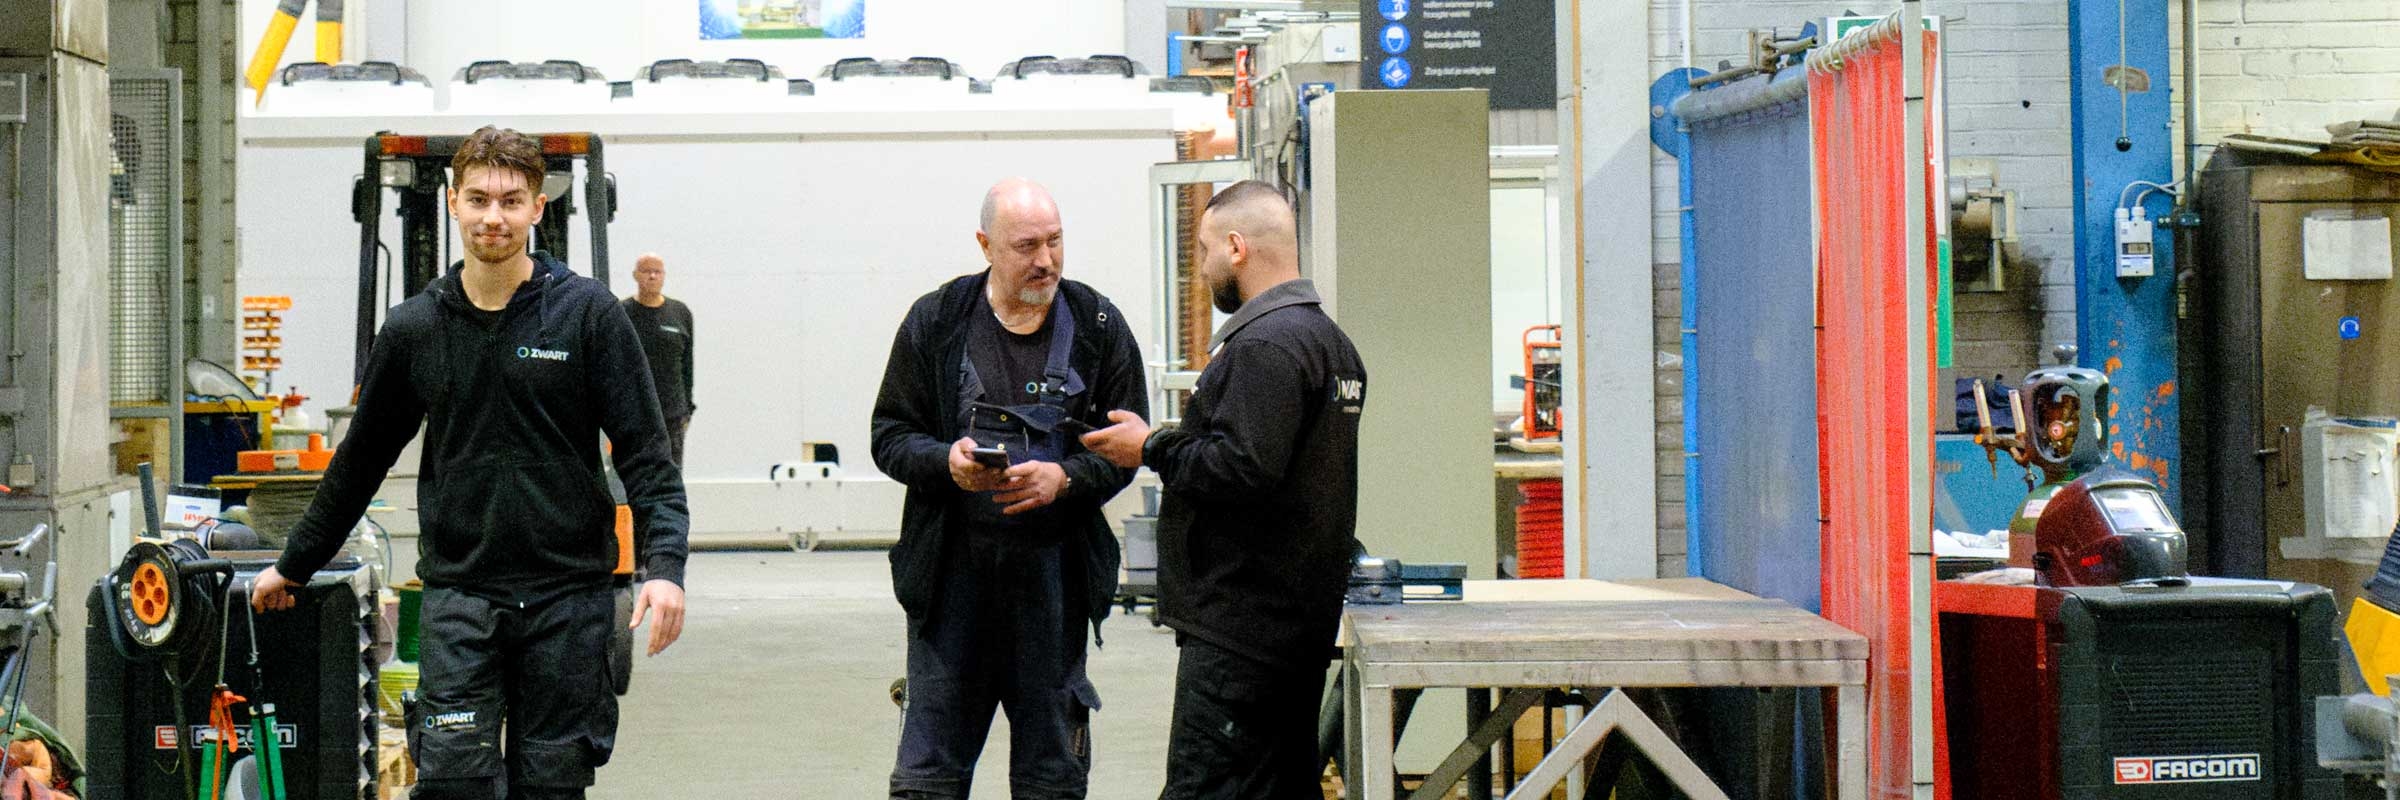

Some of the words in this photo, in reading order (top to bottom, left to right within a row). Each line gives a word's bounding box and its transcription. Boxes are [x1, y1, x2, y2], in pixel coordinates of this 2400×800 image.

[530, 348, 569, 361] ZWART
[435, 711, 476, 726] ZWART
[2154, 758, 2257, 779] FACOM
